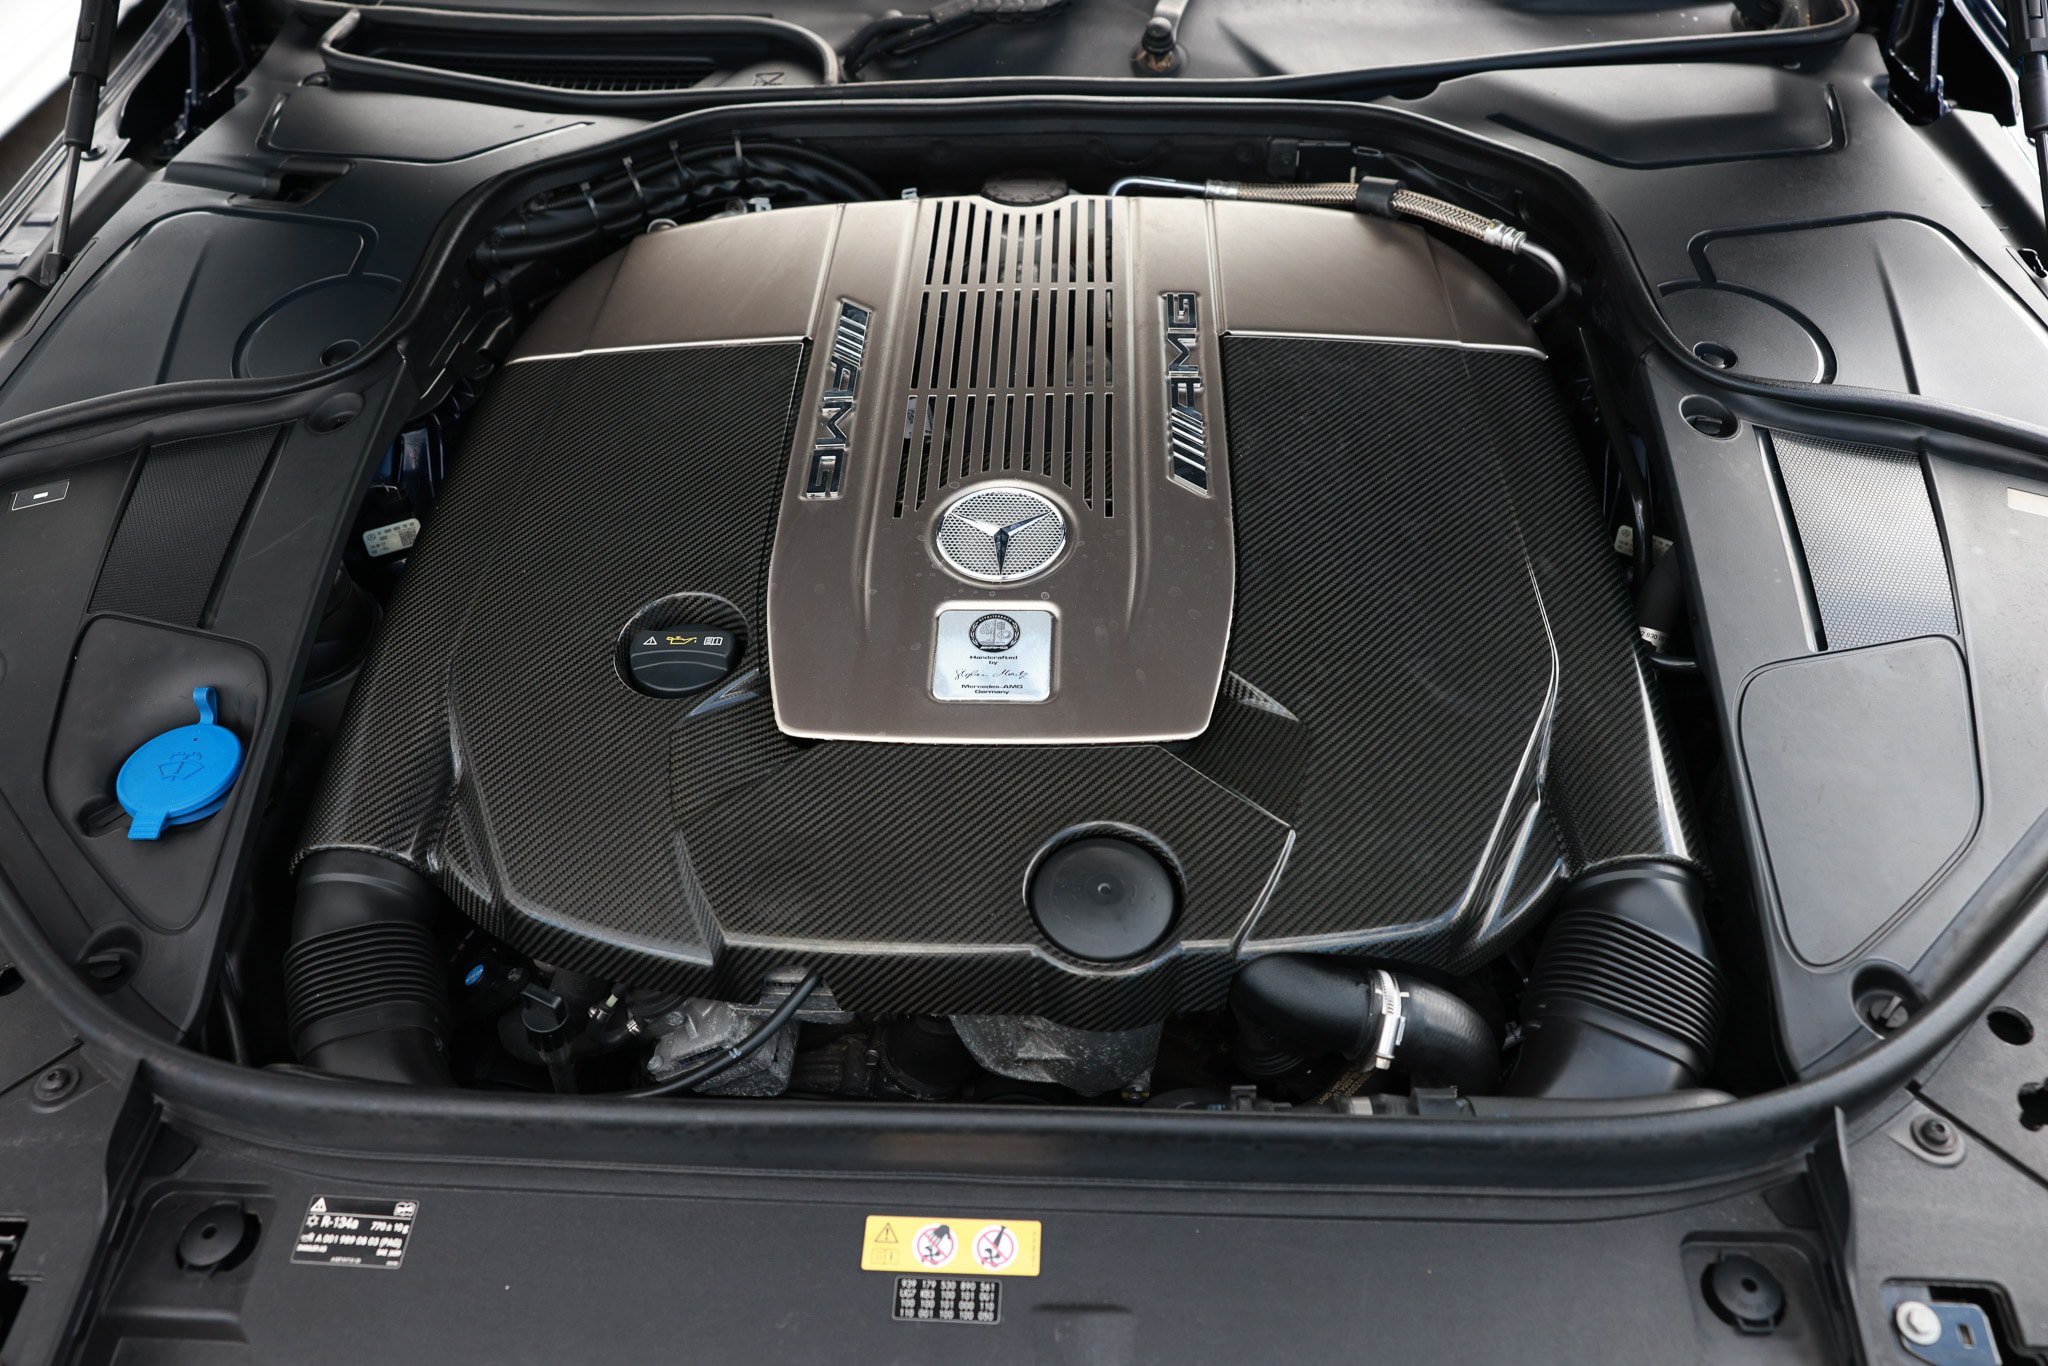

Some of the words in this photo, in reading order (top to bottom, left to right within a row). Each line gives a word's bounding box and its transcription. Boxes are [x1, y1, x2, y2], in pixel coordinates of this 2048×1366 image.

[806, 352, 862, 498] AMG
[1167, 292, 1204, 426] AMG
[320, 1216, 359, 1230] R-134a
